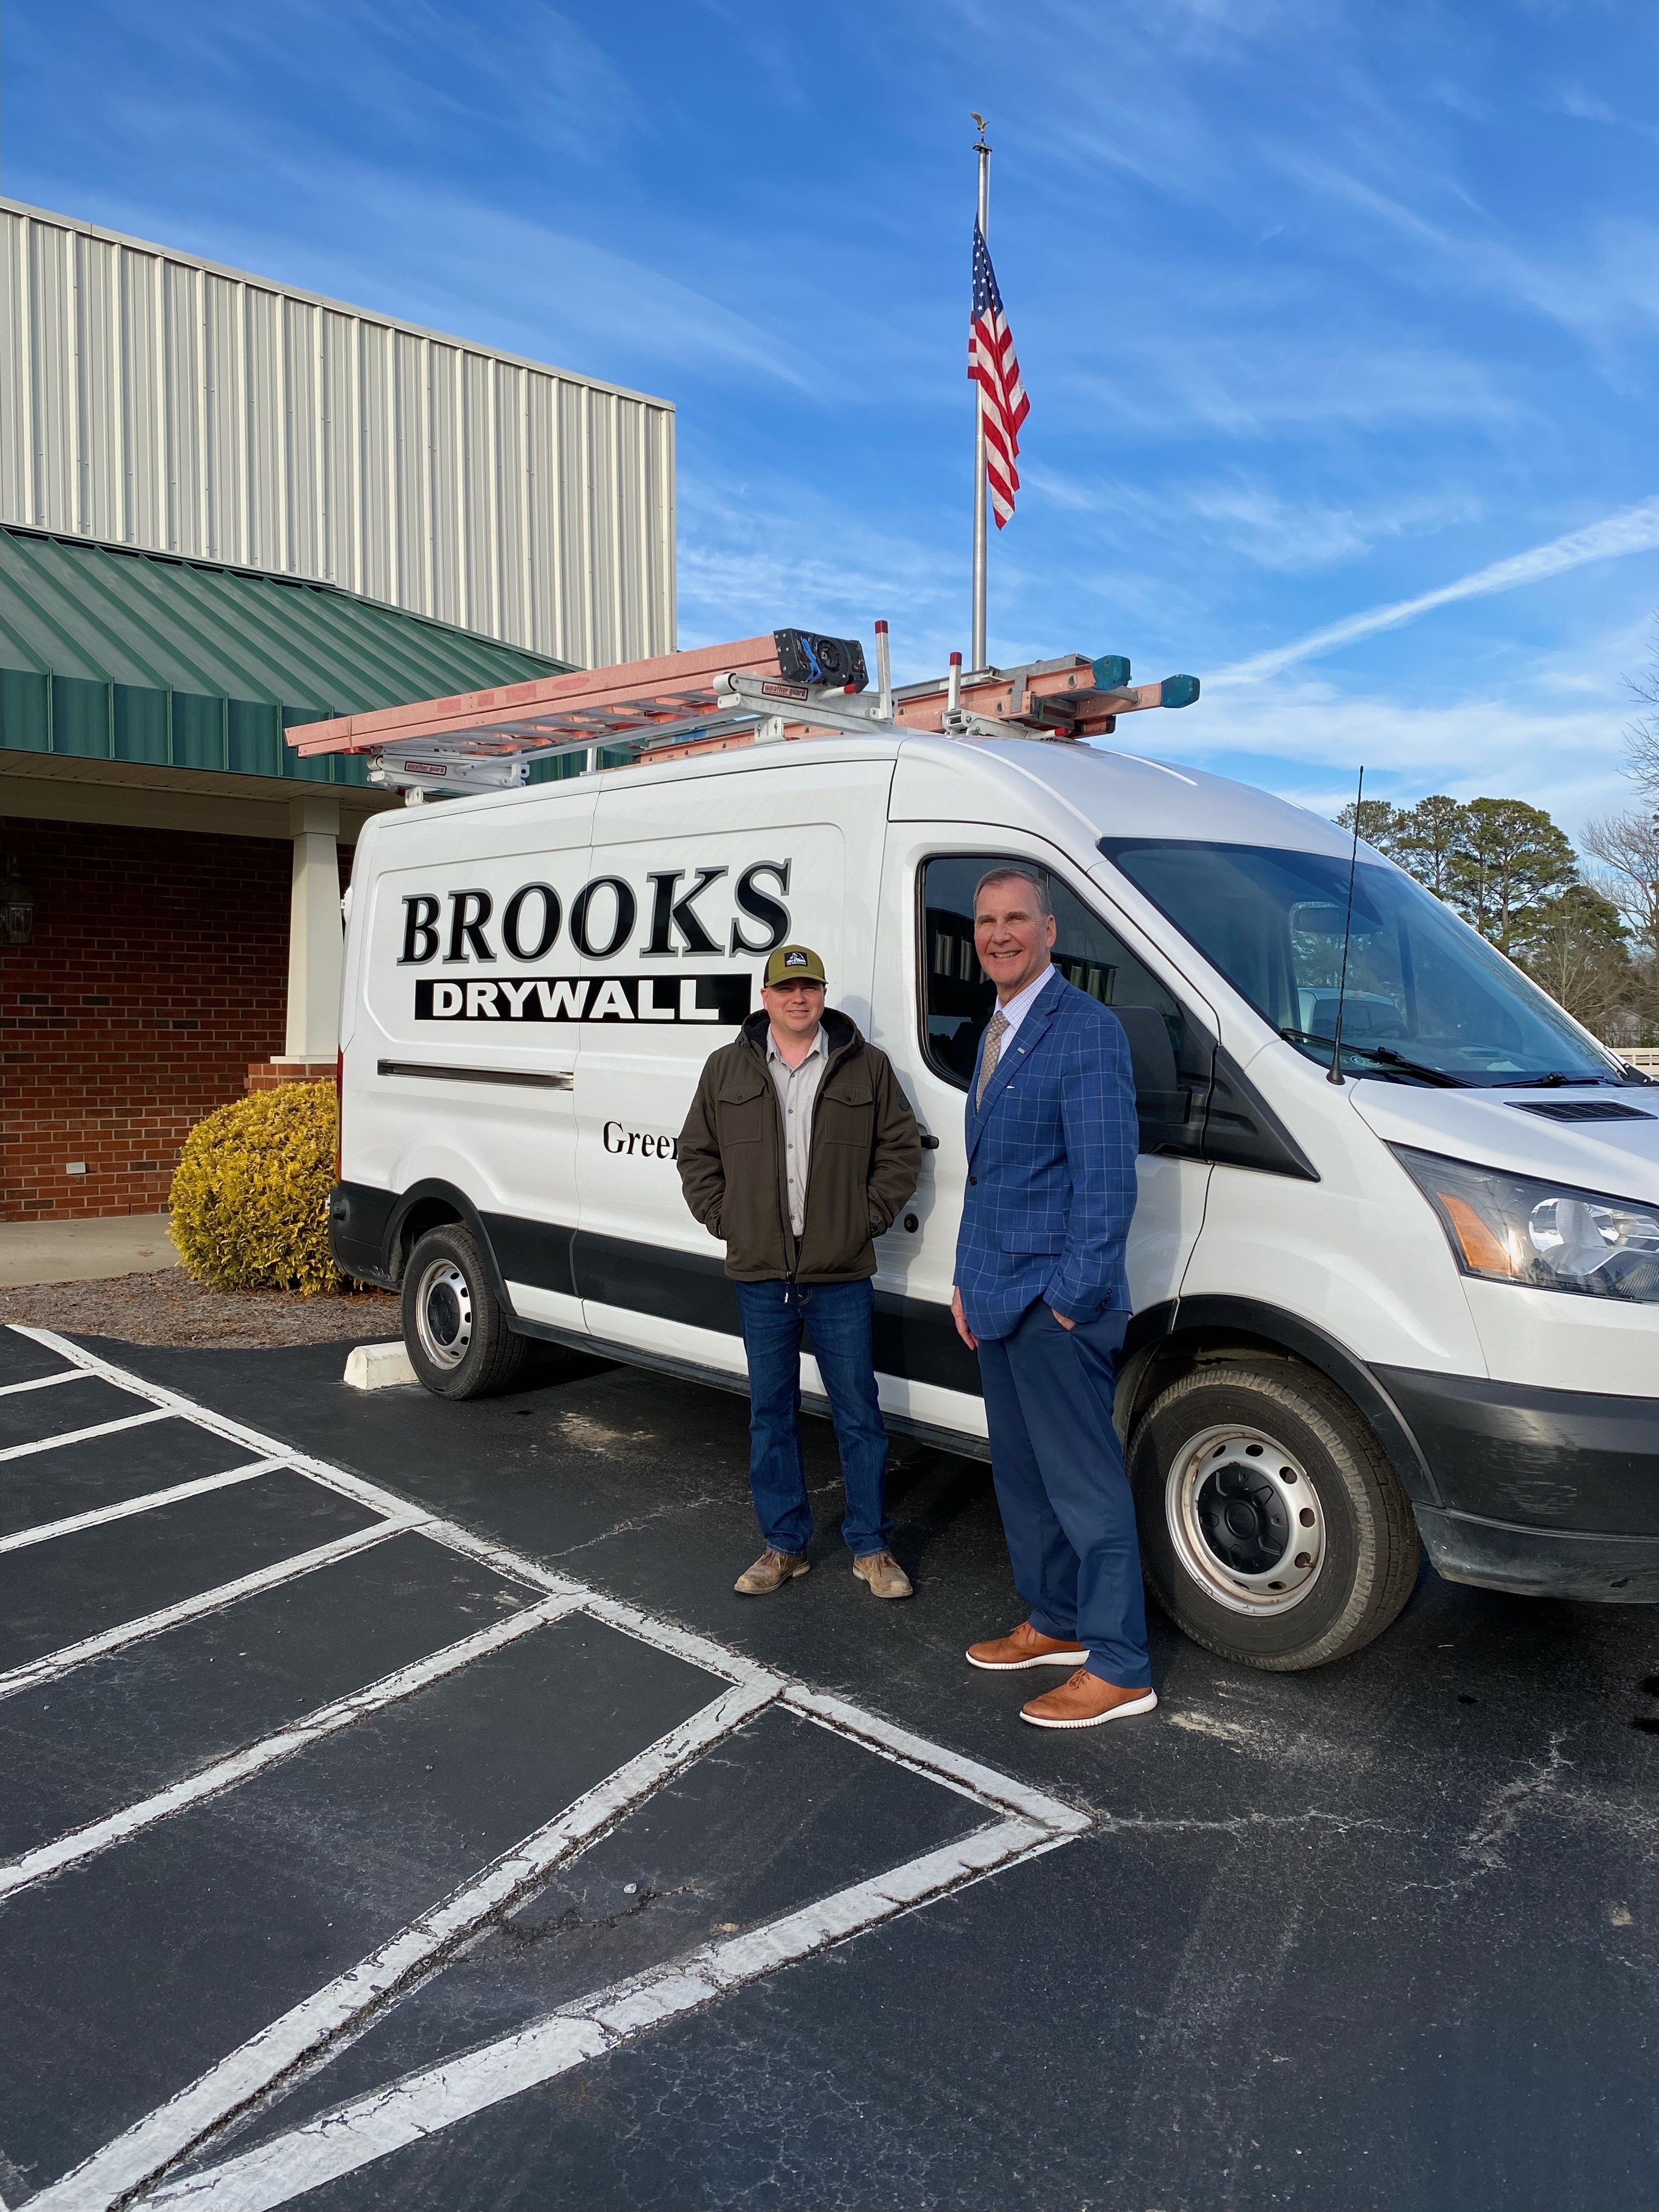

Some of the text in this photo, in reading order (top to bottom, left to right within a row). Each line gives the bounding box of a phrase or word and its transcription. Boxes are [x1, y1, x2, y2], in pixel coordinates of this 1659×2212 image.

[765, 685, 788, 694] weather
[396, 858, 792, 966] BROOKS
[433, 979, 720, 1020] DRYWALL
